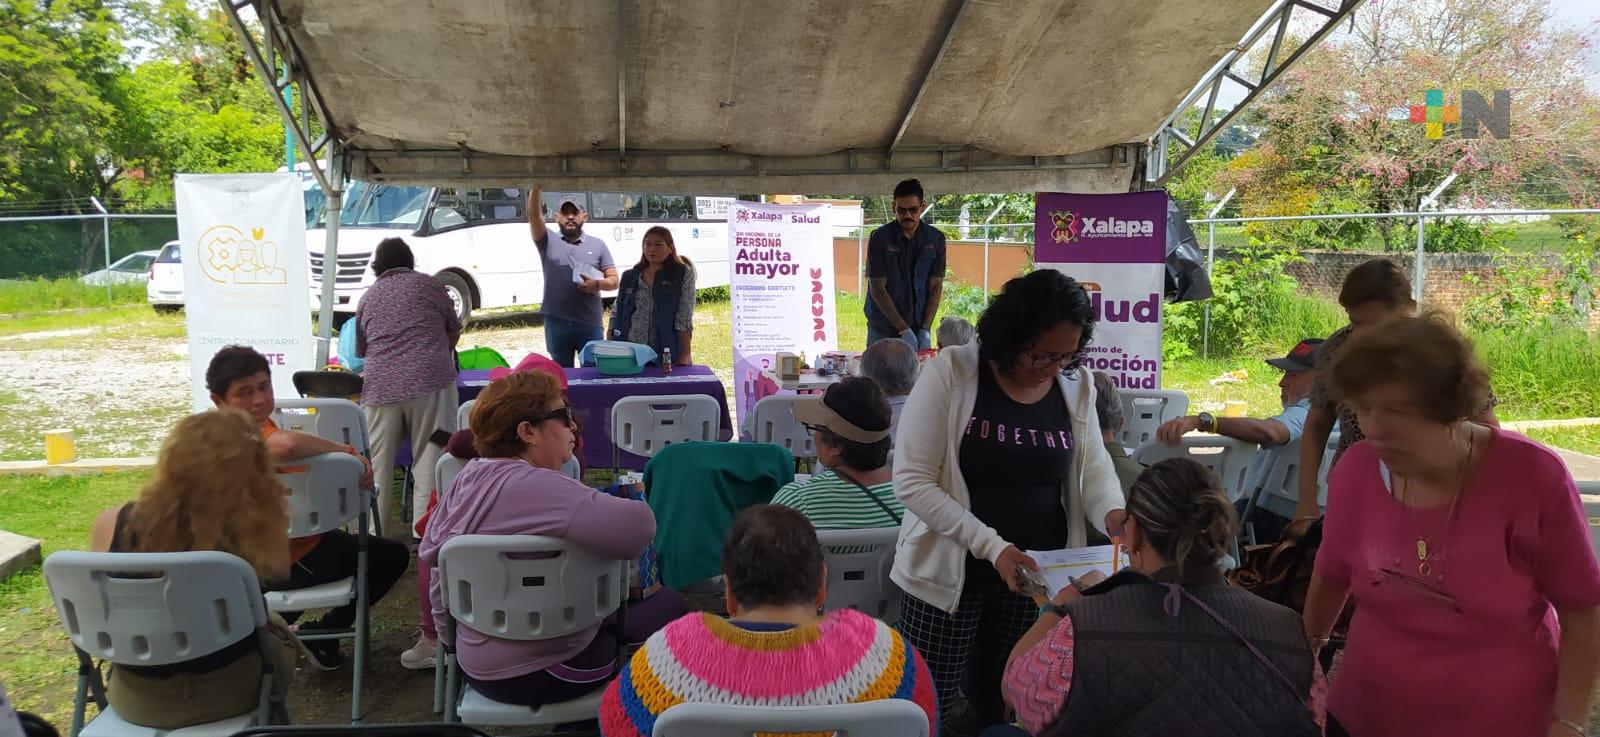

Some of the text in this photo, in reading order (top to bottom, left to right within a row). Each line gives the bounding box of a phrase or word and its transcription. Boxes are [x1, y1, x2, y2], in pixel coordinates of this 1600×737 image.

[751, 211, 820, 223] Xalapa Salud
[1081, 217, 1154, 238] Xalapa
[736, 237, 782, 248] PERSONA
[736, 248, 792, 261] Adulta
[735, 262, 799, 279] mayor
[1091, 292, 1160, 323] lud
[198, 337, 300, 346] CENTRO COMUNITARIO
[966, 416, 1074, 449] TOGETHE
